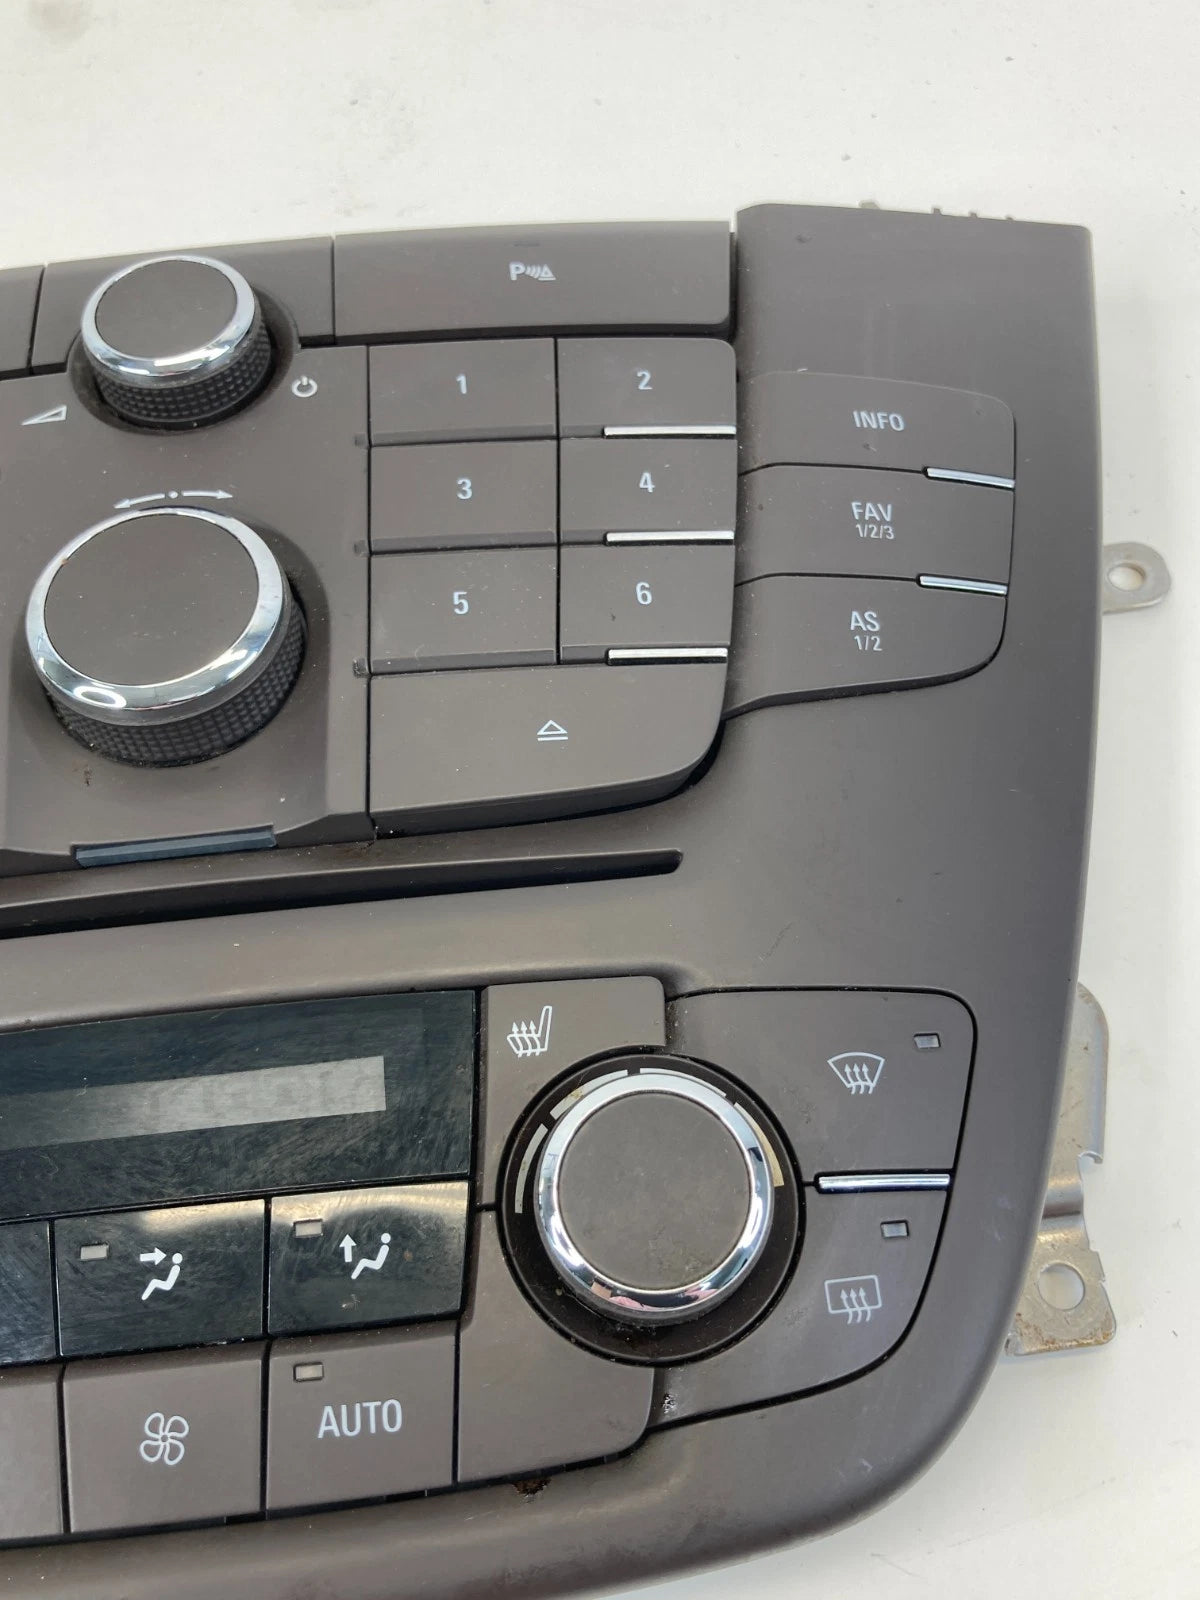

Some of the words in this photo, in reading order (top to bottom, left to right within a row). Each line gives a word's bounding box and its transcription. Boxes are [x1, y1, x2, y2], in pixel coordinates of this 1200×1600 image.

[456, 374, 468, 395] 1
[636, 370, 653, 390] 2
[852, 410, 905, 432] INFO
[457, 478, 473, 500] 3
[639, 472, 656, 493] 4
[851, 501, 893, 522] FAV
[855, 523, 895, 540] 1/2/3
[453, 591, 469, 615] 5
[636, 581, 653, 605] 6
[850, 610, 880, 632] AS
[854, 635, 883, 652] 1/2
[317, 1398, 403, 1439] AUTO
